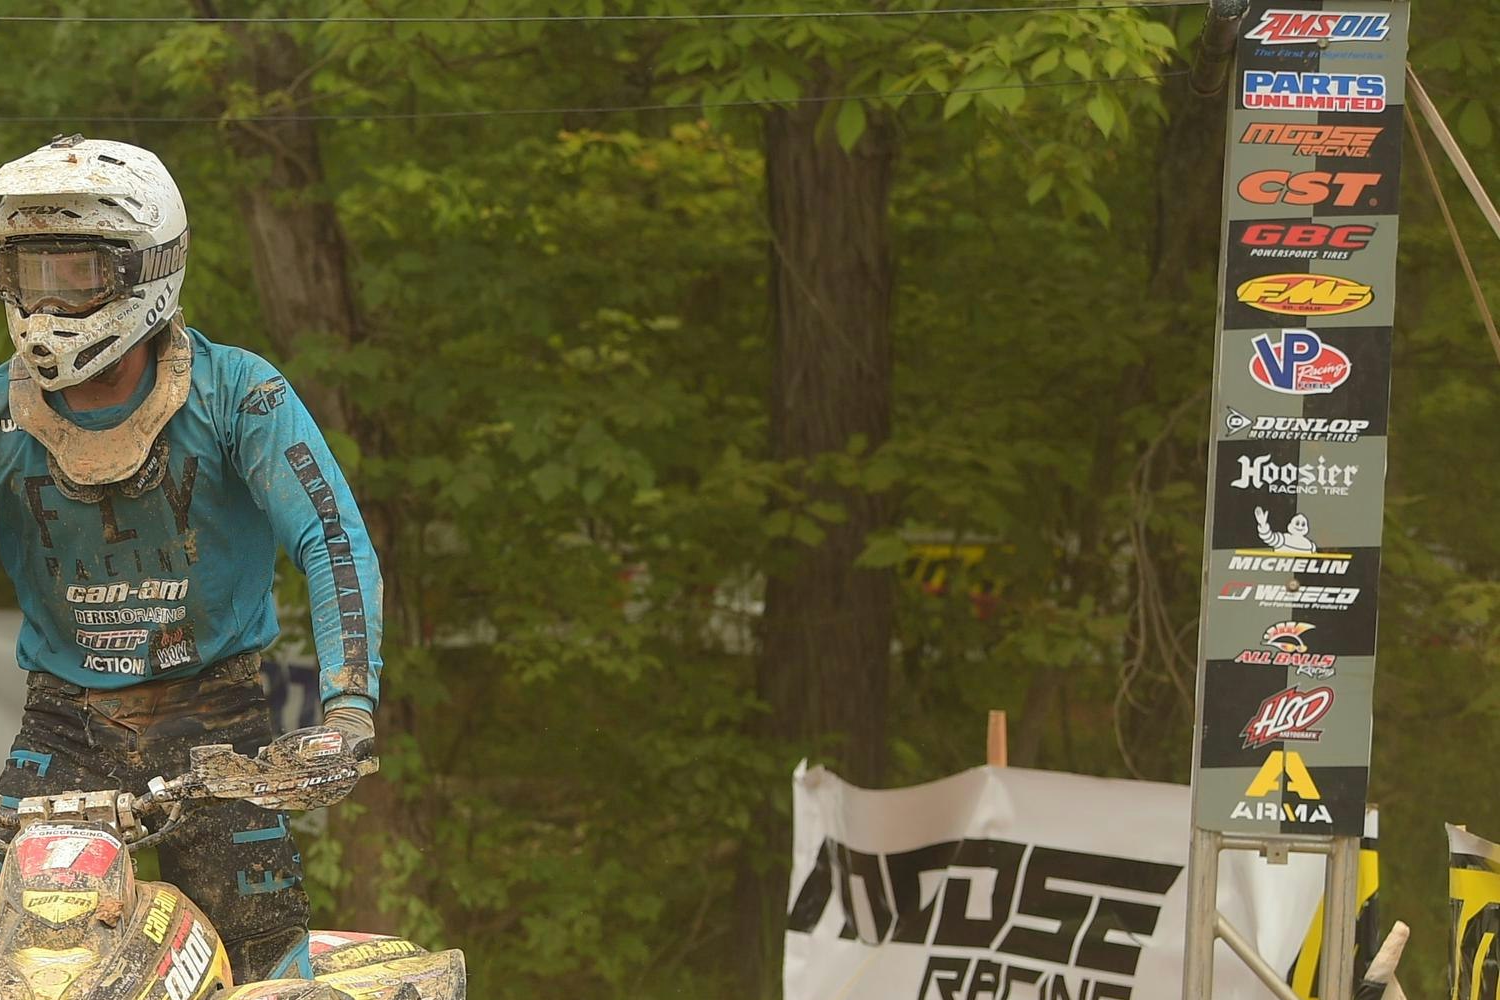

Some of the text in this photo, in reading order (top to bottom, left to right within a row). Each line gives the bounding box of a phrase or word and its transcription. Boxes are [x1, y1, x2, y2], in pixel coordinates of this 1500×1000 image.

[1250, 12, 1390, 42] AMSOIL
[1246, 73, 1384, 96] PARTS
[1245, 95, 1384, 110] UNLIMITED
[1241, 123, 1384, 144] MOOSE
[1295, 145, 1370, 157] RACING
[1238, 170, 1382, 206] CST
[1241, 224, 1376, 248] GBC
[1250, 248, 1349, 260] POWERSPORTS TIRES
[1238, 279, 1372, 305] FMF
[145, 282, 174, 327] 001
[1254, 331, 1321, 390] VP
[1298, 362, 1352, 381] Racing
[1252, 416, 1370, 434] DUNLOP
[1249, 430, 1359, 442] MOTORCYCLE TIRES
[1231, 454, 1359, 489] Hoosier
[1269, 485, 1349, 496] RACING TIRE
[1229, 556, 1350, 575] MICHELIN
[66, 579, 189, 603] can-am
[1259, 600, 1348, 611] Performance Products
[1235, 650, 1337, 666] ALL BALLS
[1230, 802, 1333, 824] ARMA
[45, 837, 91, 870] 1
